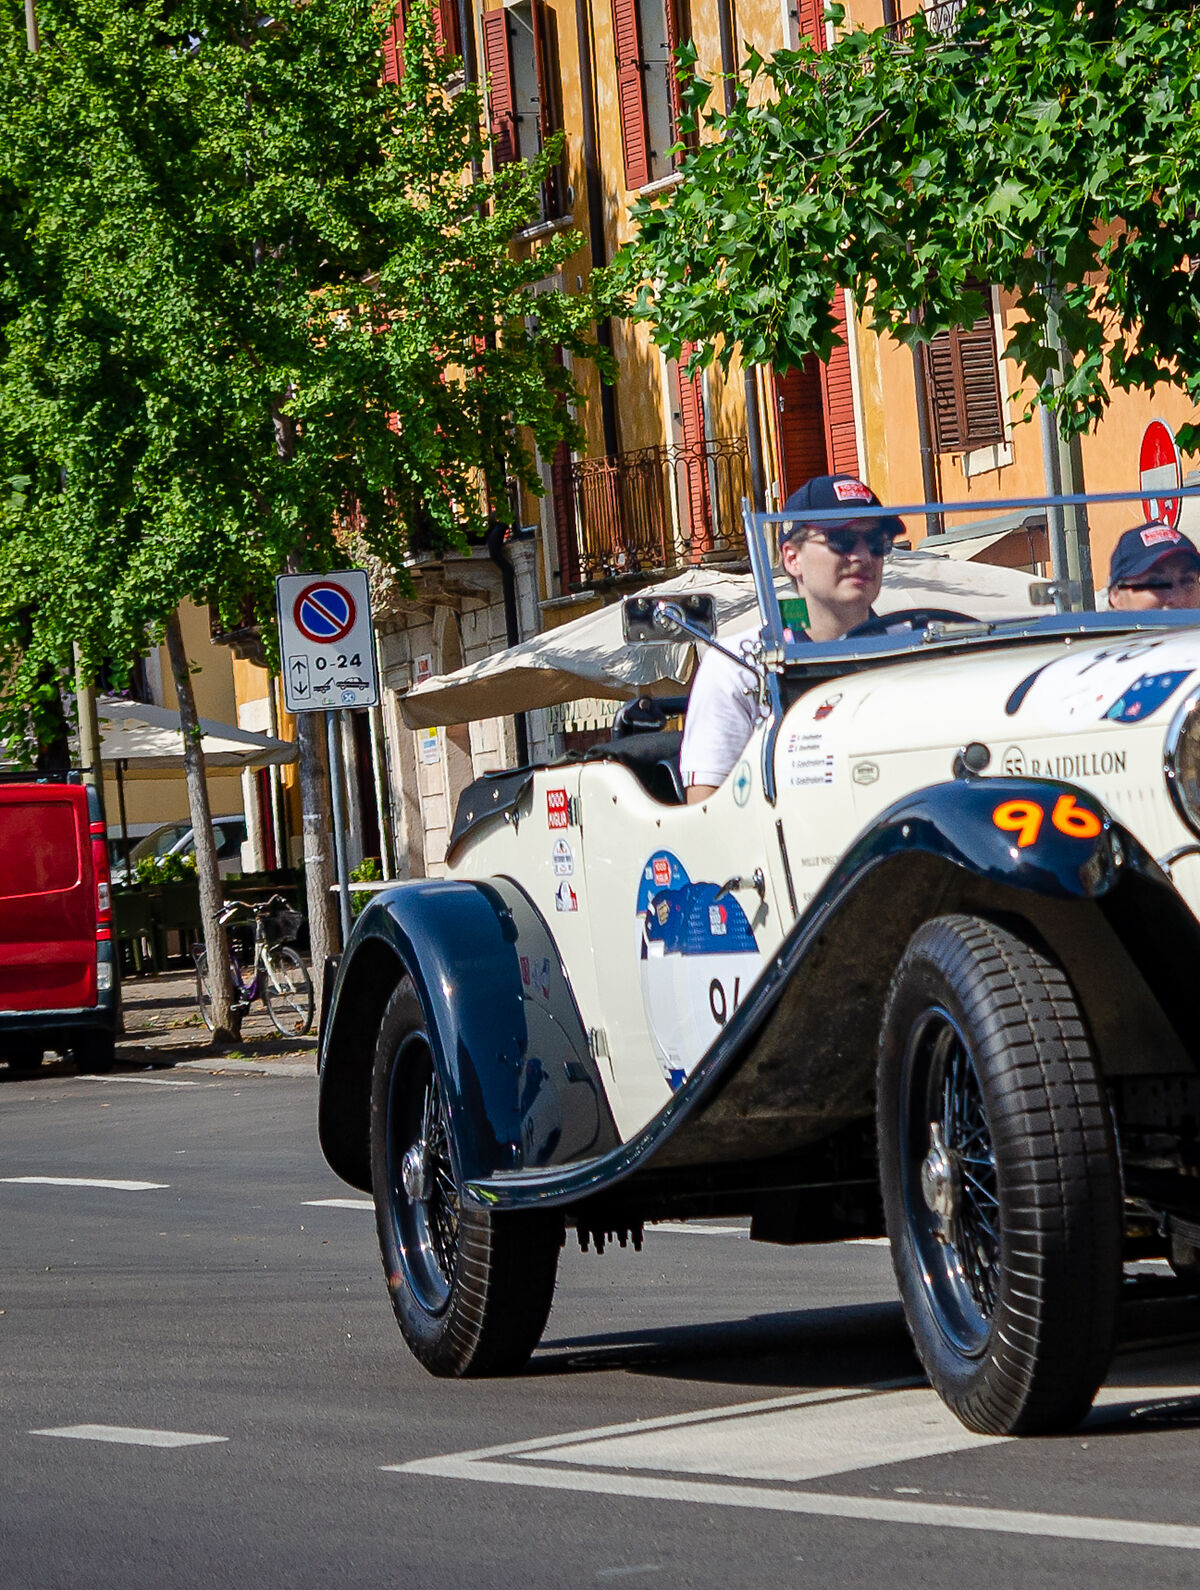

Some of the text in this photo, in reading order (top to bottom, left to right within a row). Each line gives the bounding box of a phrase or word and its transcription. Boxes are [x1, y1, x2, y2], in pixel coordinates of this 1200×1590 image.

[315, 653, 362, 670] 0-24
[1032, 751, 1127, 778] RAIDILLON
[992, 794, 1102, 848] 96
